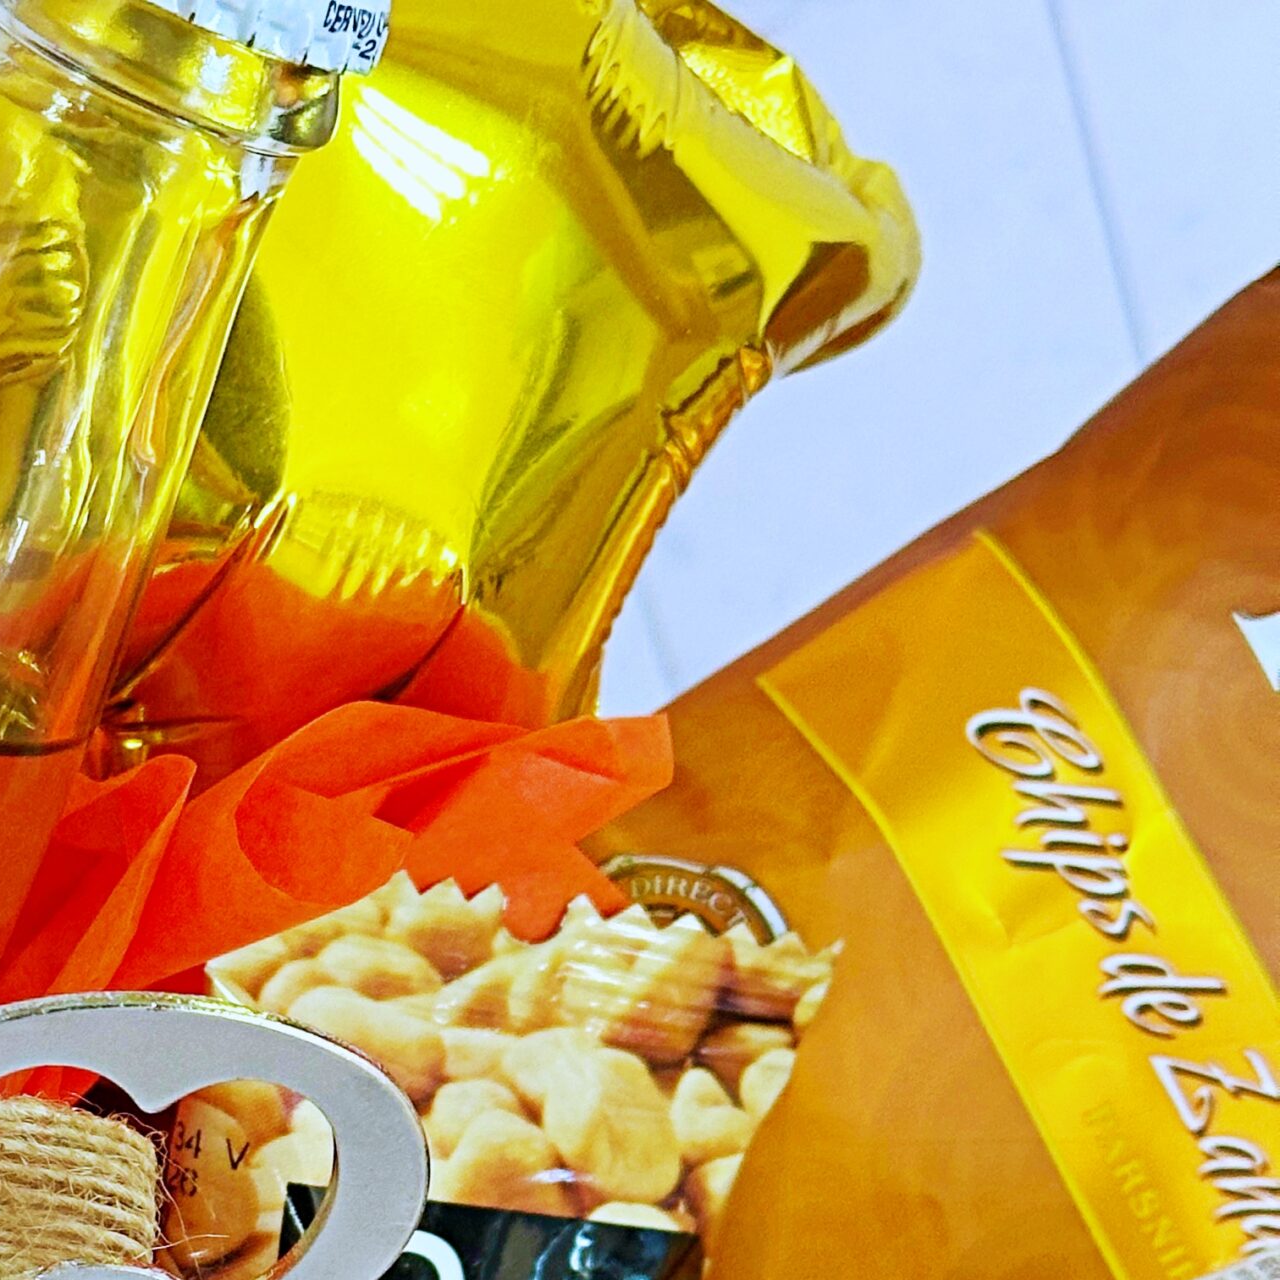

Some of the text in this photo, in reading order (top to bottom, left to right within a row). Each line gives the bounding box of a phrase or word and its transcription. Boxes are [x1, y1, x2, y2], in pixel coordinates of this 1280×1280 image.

[324, 0, 377, 38] CERV
[965, 687, 1155, 940] Chips
[1098, 954, 1228, 1039] de
[226, 1138, 250, 1170] V
